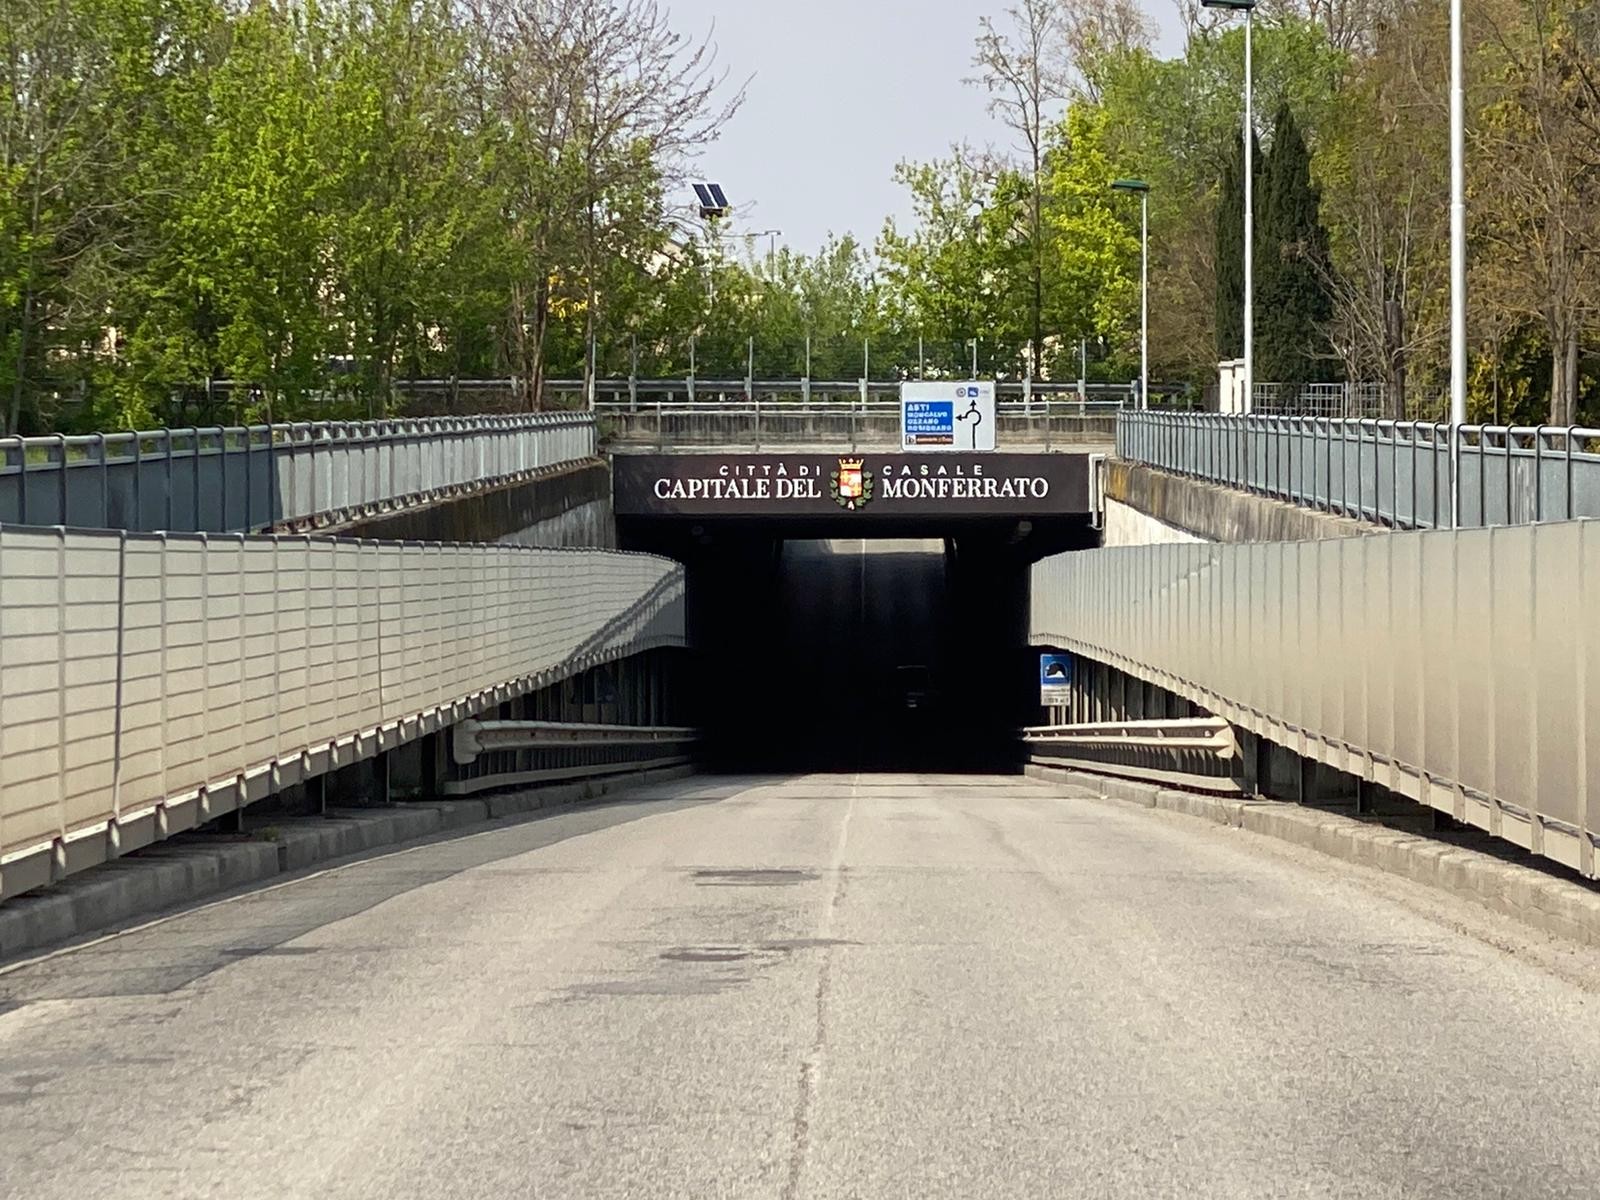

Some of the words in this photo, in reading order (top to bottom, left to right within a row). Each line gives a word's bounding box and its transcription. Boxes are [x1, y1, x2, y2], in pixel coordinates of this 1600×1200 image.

[719, 463, 788, 476] CITTÀ
[800, 465, 821, 476] DI
[882, 465, 983, 476] CASALE
[654, 478, 770, 499] CAPITALE
[776, 478, 821, 499] DEL
[882, 478, 1049, 498] MONFERRATO
